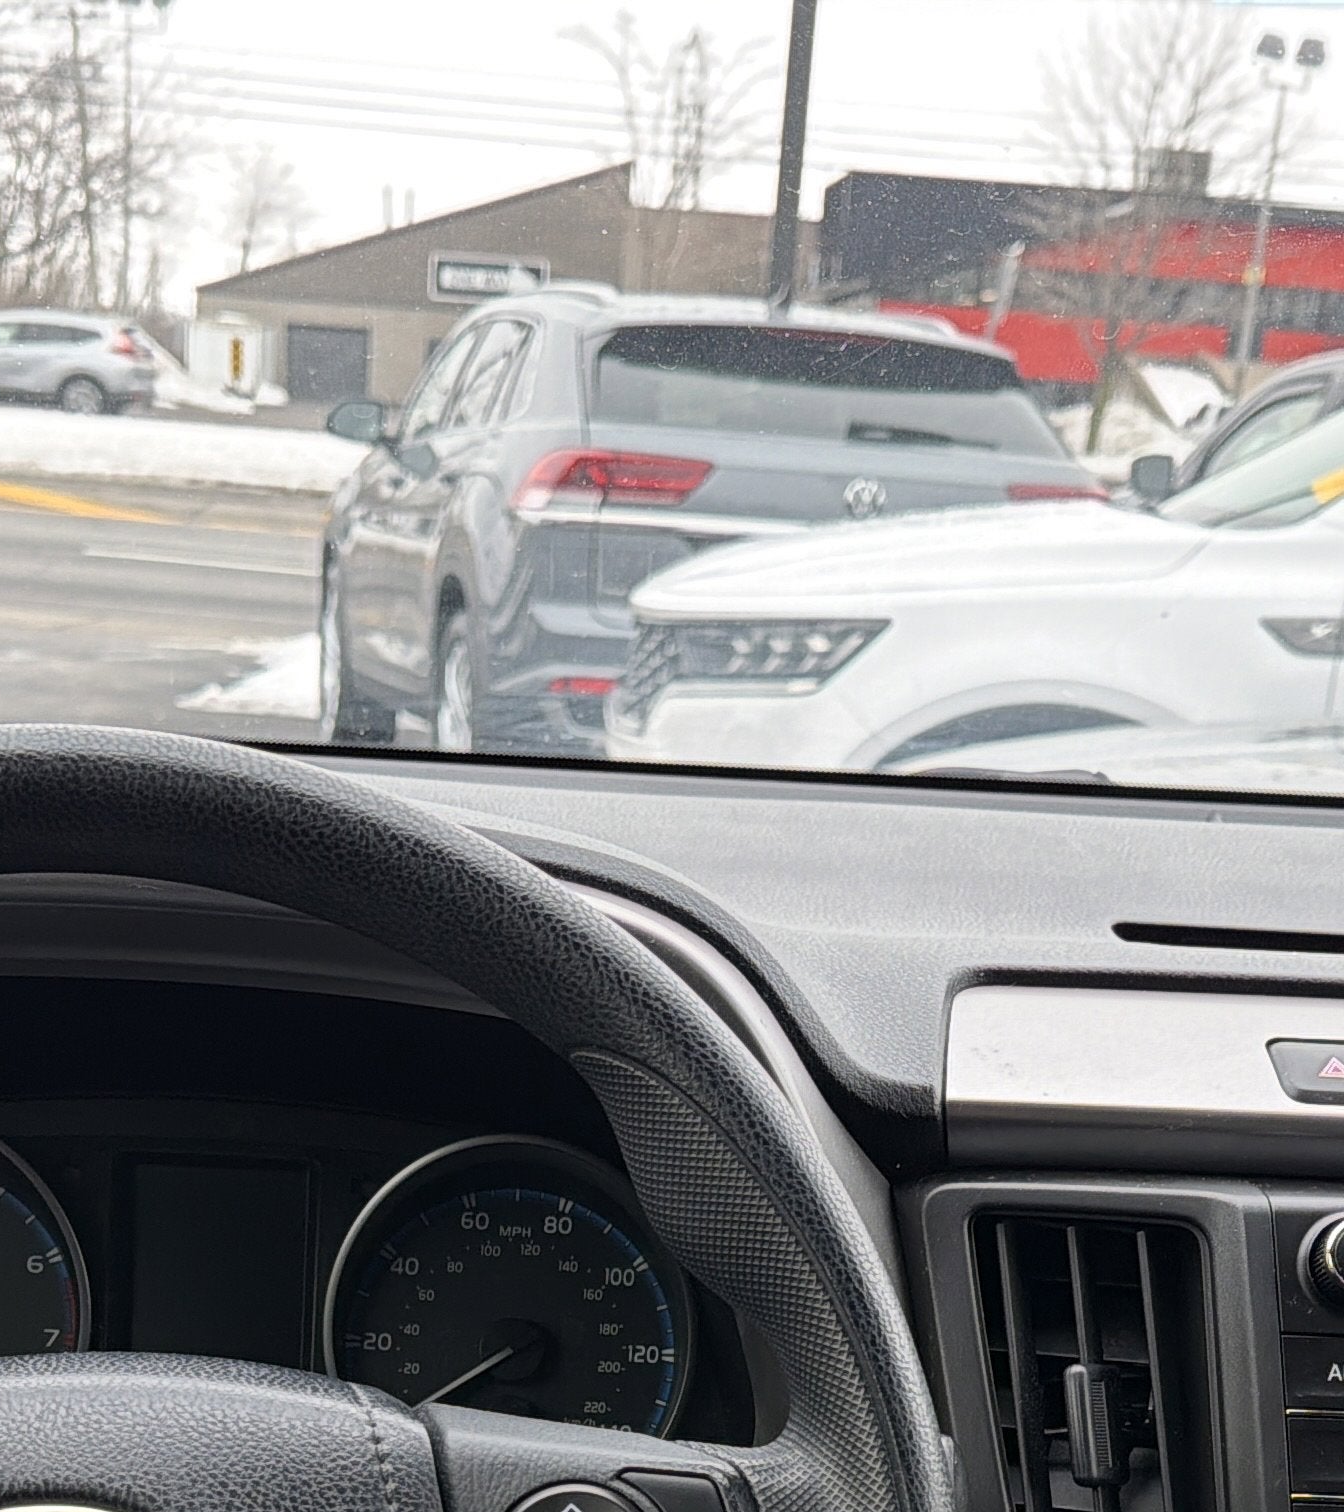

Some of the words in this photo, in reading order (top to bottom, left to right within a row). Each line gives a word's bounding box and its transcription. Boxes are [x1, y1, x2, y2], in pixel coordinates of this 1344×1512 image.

[460, 1212, 490, 1231] 60
[543, 1216, 573, 1235] 80
[499, 1225, 532, 1239] MPH
[481, 1244, 501, 1257] 100
[521, 1244, 541, 1257] 120
[27, 1256, 44, 1274] 6
[390, 1257, 419, 1276] 40
[447, 1261, 463, 1274] 80
[558, 1259, 579, 1273] 140
[604, 1267, 635, 1288] 100
[418, 1289, 435, 1302] 60
[583, 1288, 603, 1302] 160
[403, 1323, 420, 1337] 40
[599, 1323, 619, 1336] 180
[43, 1329, 60, 1348] 7
[362, 1332, 393, 1351] 20
[627, 1344, 659, 1364] 120
[403, 1362, 420, 1375] 20
[597, 1362, 621, 1374] 200
[583, 1402, 607, 1415] 220
